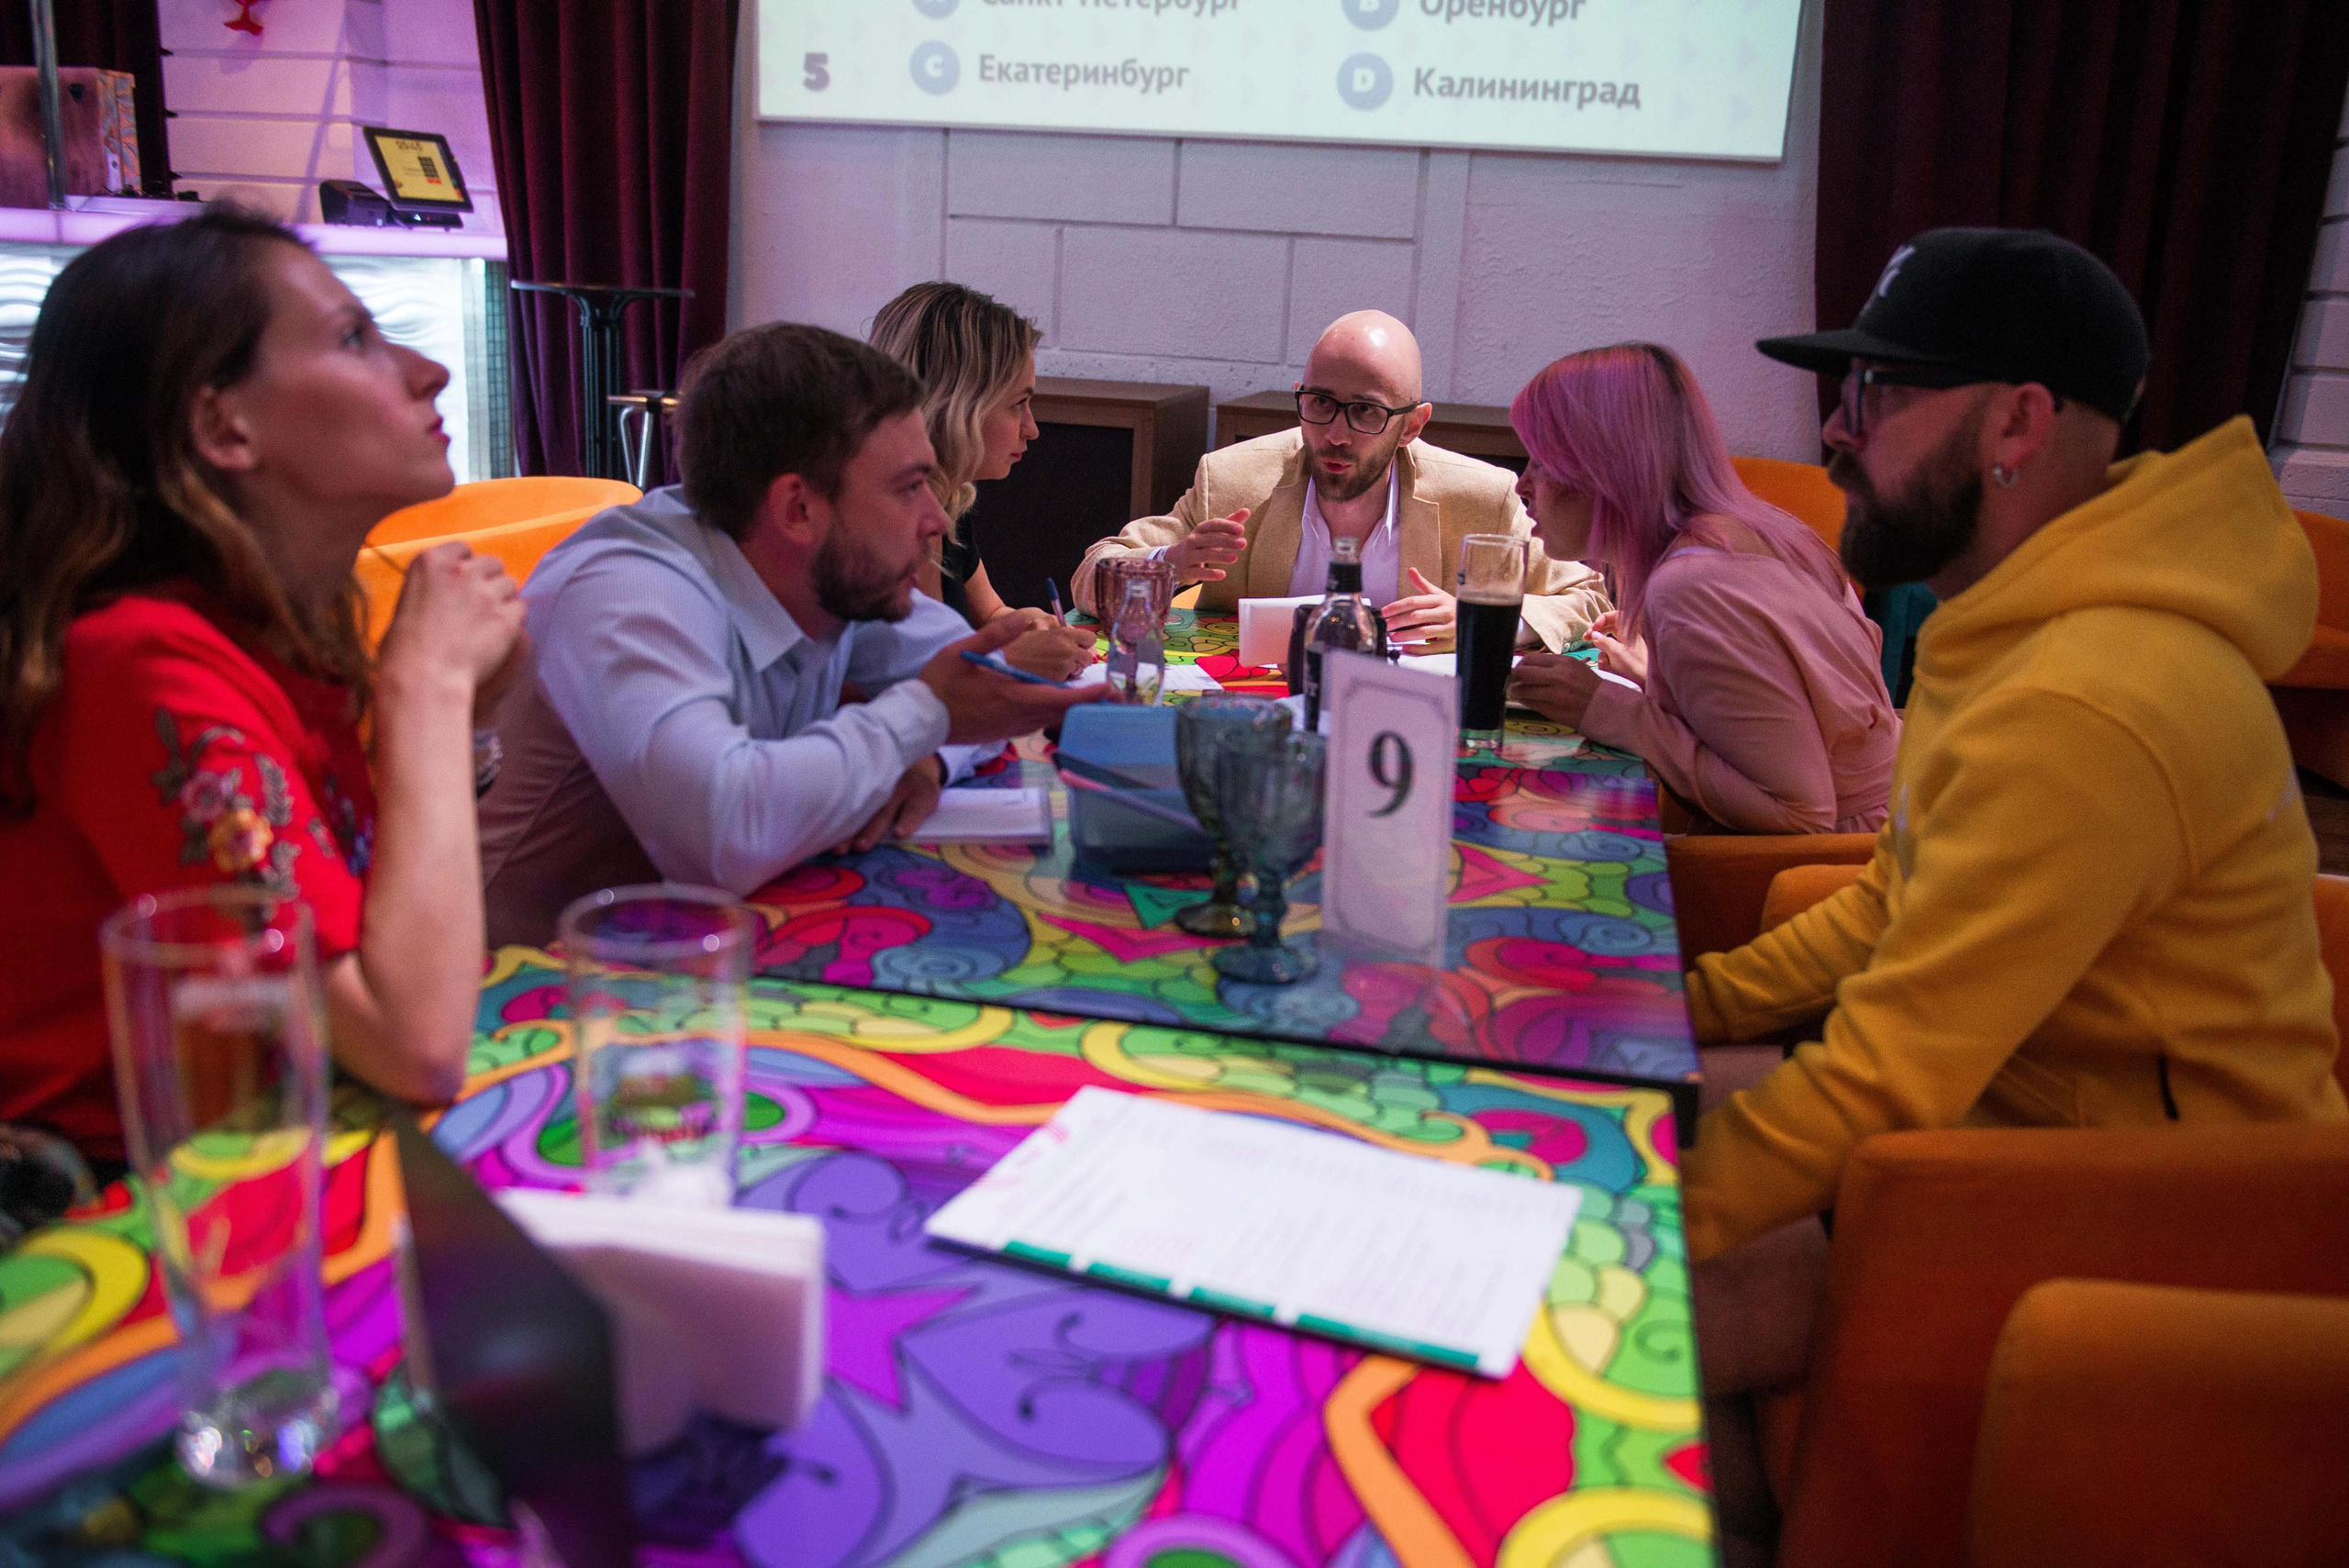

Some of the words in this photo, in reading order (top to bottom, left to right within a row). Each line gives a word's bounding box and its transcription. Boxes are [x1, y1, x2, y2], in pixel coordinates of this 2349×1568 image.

[803, 52, 830, 92] 5
[978, 53, 1190, 95] Екатеринбург
[1413, 67, 1642, 111] Калининград
[1367, 730, 1414, 817] 9
